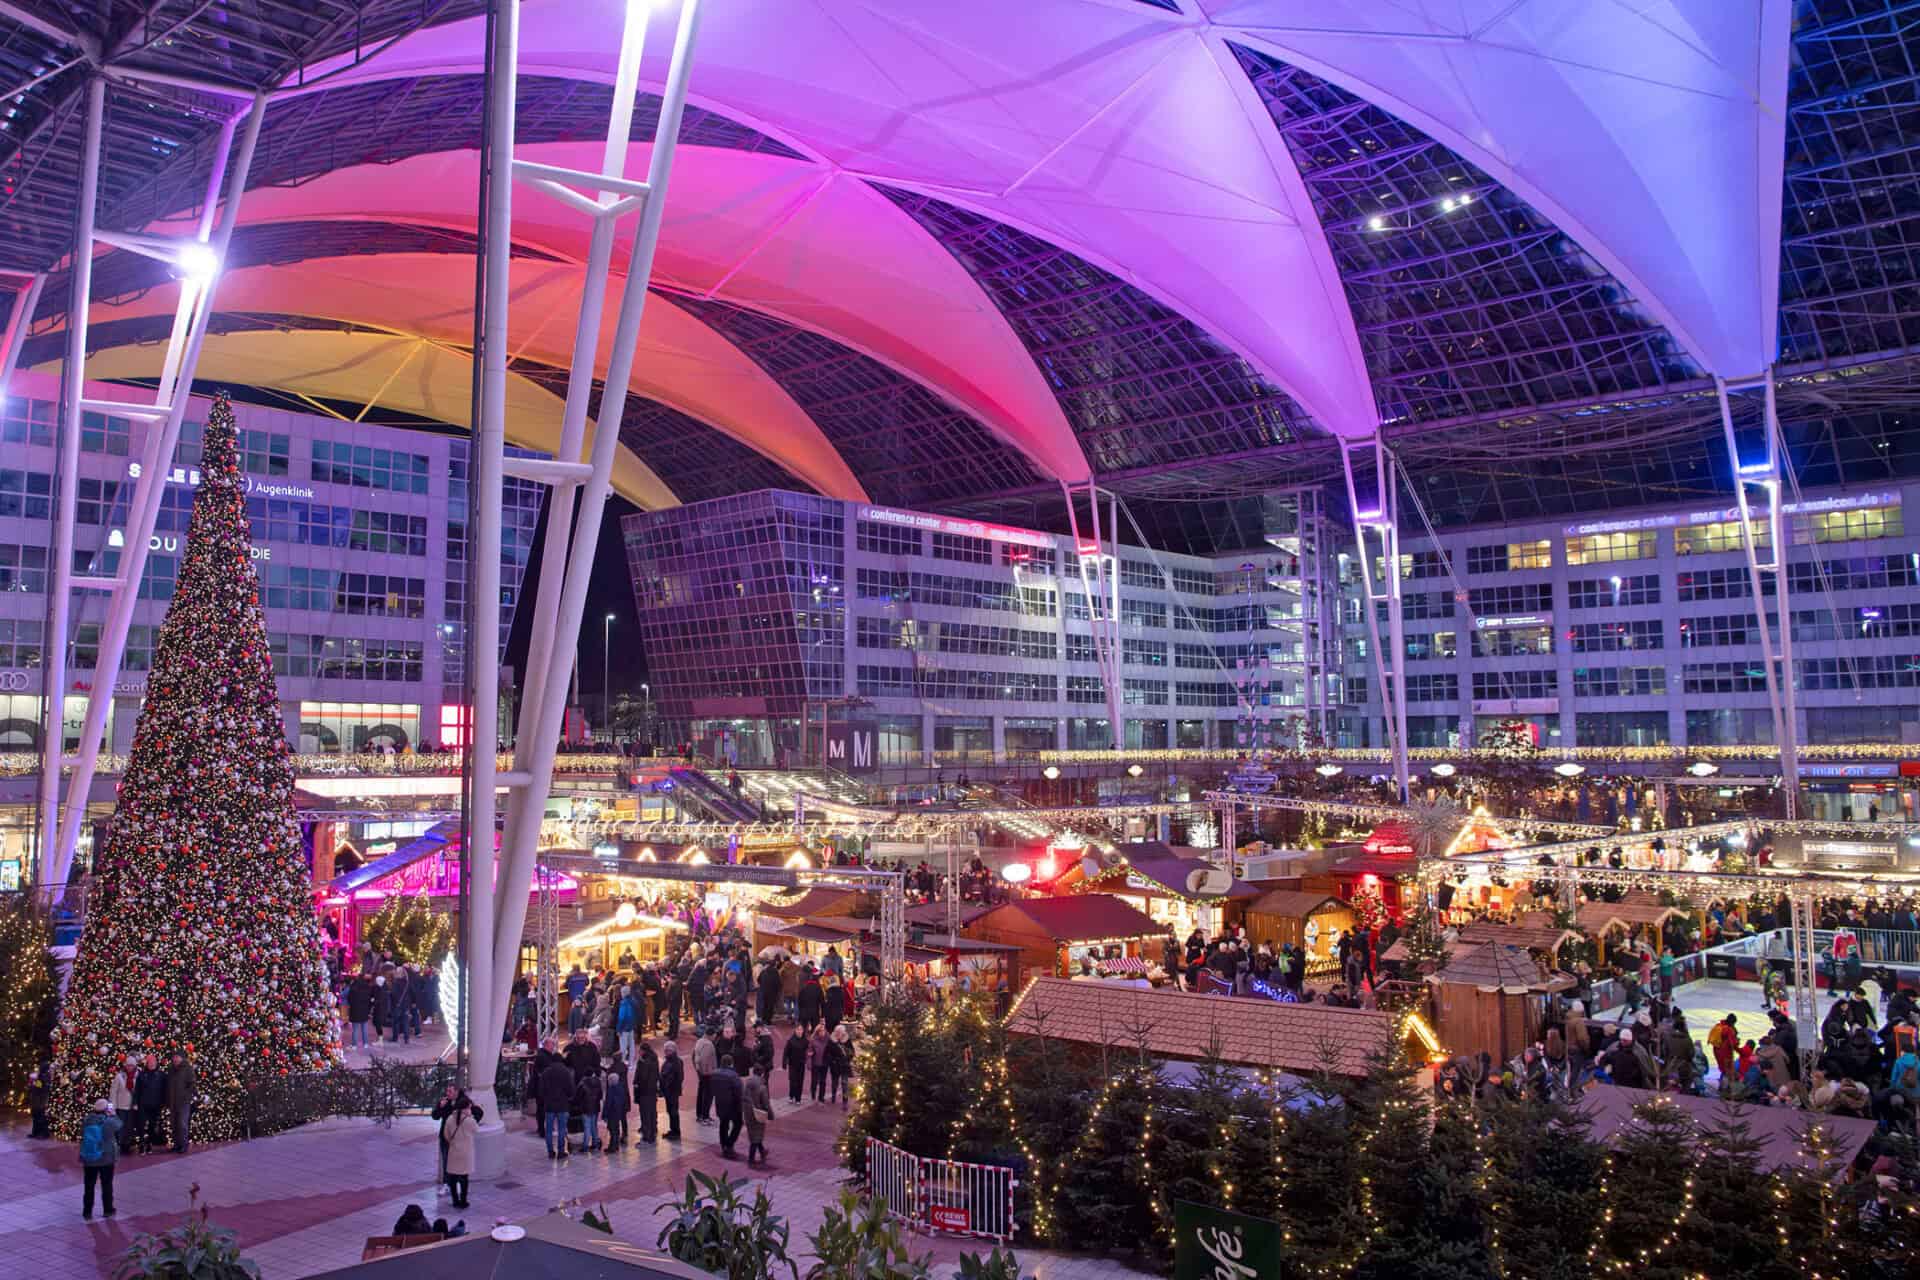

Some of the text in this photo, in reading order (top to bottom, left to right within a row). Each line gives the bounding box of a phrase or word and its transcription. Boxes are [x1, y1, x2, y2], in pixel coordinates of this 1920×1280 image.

[255, 481, 314, 499] Augenklinik
[150, 537, 177, 552] OU
[829, 731, 871, 767] M M
